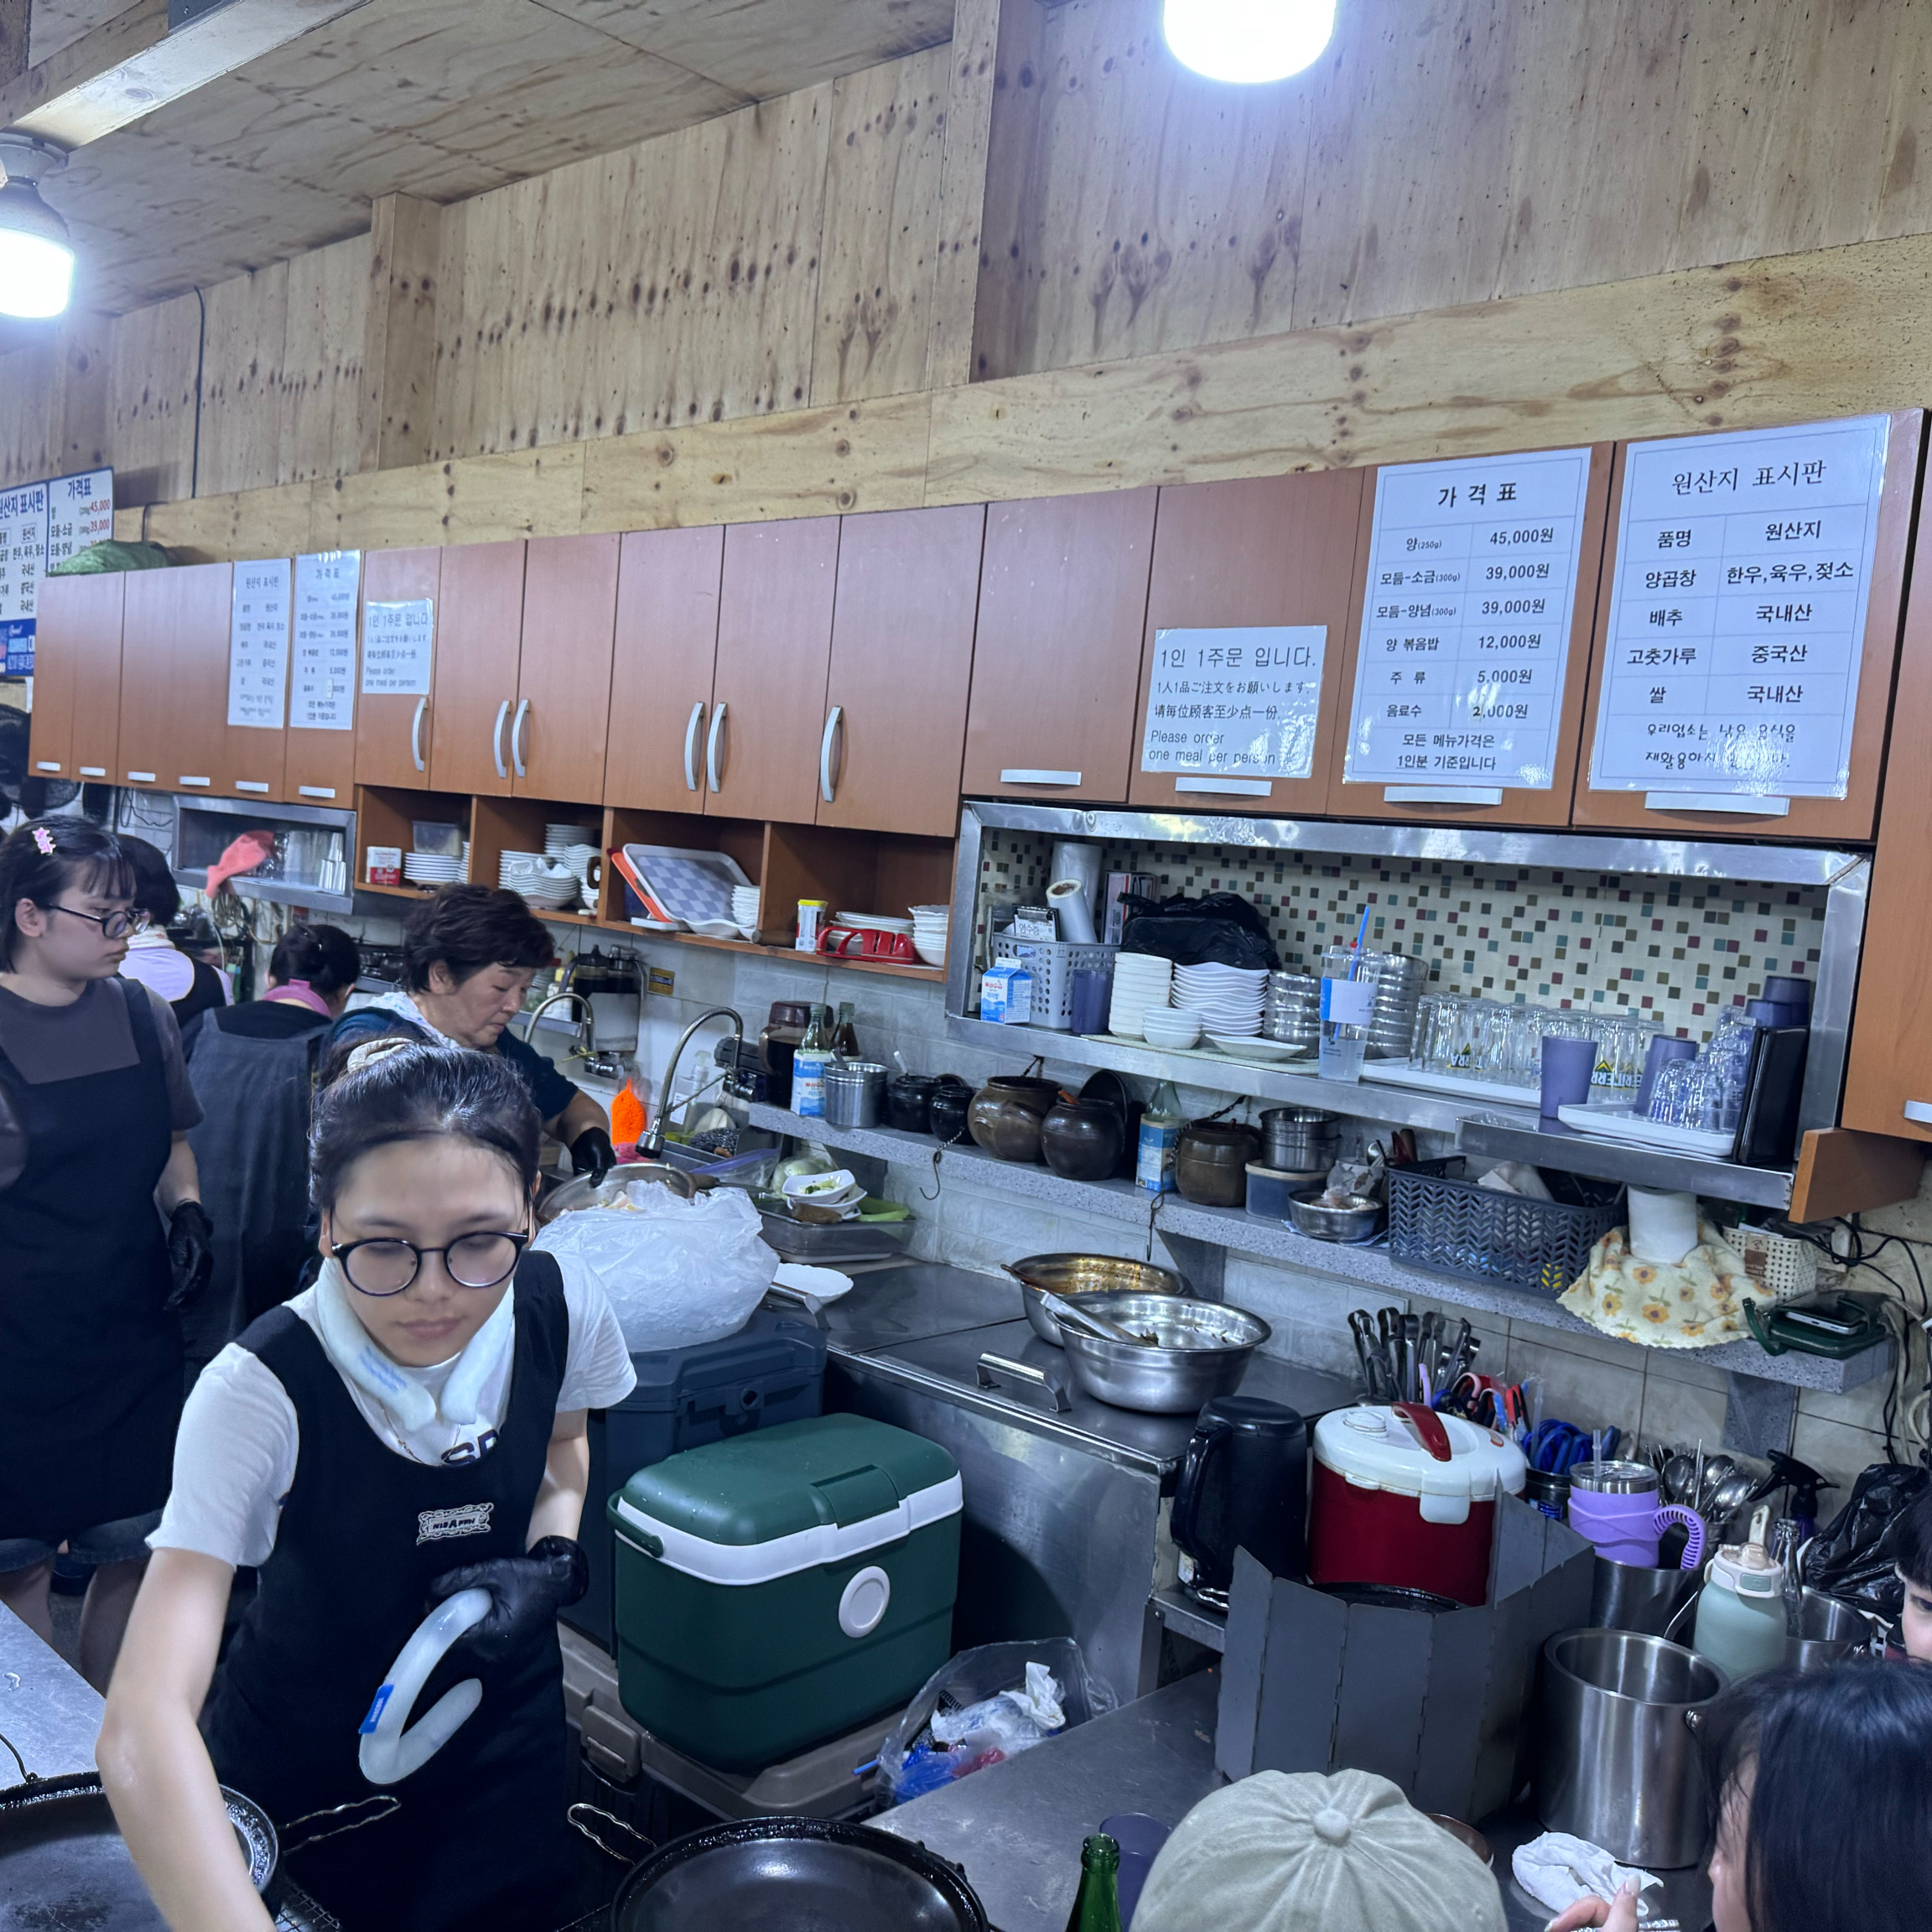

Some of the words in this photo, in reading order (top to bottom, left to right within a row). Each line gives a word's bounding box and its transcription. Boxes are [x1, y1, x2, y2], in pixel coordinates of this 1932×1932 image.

[1672, 467, 1739, 496] 원산지
[1752, 460, 1827, 489] 표시판
[68, 477, 91, 500] 가격표
[20, 488, 44, 514] 표시판
[1490, 527, 1554, 546] 45,000원
[1657, 528, 1692, 549] 품명
[1765, 520, 1821, 543] 원산지
[1486, 563, 1550, 581] 39,000원
[1645, 569, 1696, 589] 양곱창
[1727, 561, 1854, 585] 한우,육우,젖소
[1482, 599, 1545, 616] 39,000원
[1756, 604, 1812, 623] 국내산
[1649, 610, 1684, 628] 배추
[1386, 638, 1397, 652] 양
[1403, 637, 1439, 652] 볶음밥
[1478, 634, 1540, 650] 12,000원
[1161, 648, 1185, 668] 1인
[1198, 647, 1243, 668] 1주문
[1255, 647, 1316, 667] 입니다.
[1627, 647, 1697, 667] 고춧가루
[1751, 644, 1808, 664] 중국산
[1478, 669, 1532, 684] 5,000원
[1649, 686, 1667, 704] 쌀
[1747, 684, 1804, 704] 국내산
[1386, 704, 1422, 718] 음료수
[1472, 704, 1528, 719] 2,000원
[1150, 730, 1187, 744] Please
[1647, 724, 1708, 740] 우리업소는
[1402, 734, 1426, 747] 모든
[1433, 734, 1495, 749] 메뉴가격은
[1149, 750, 1170, 761] one
[1175, 749, 1202, 762] meal
[1208, 752, 1228, 764] per
[1397, 755, 1428, 769] 1인분
[1434, 756, 1496, 771] 기준입니다
[1451, 1052, 1483, 1068] TRRA
